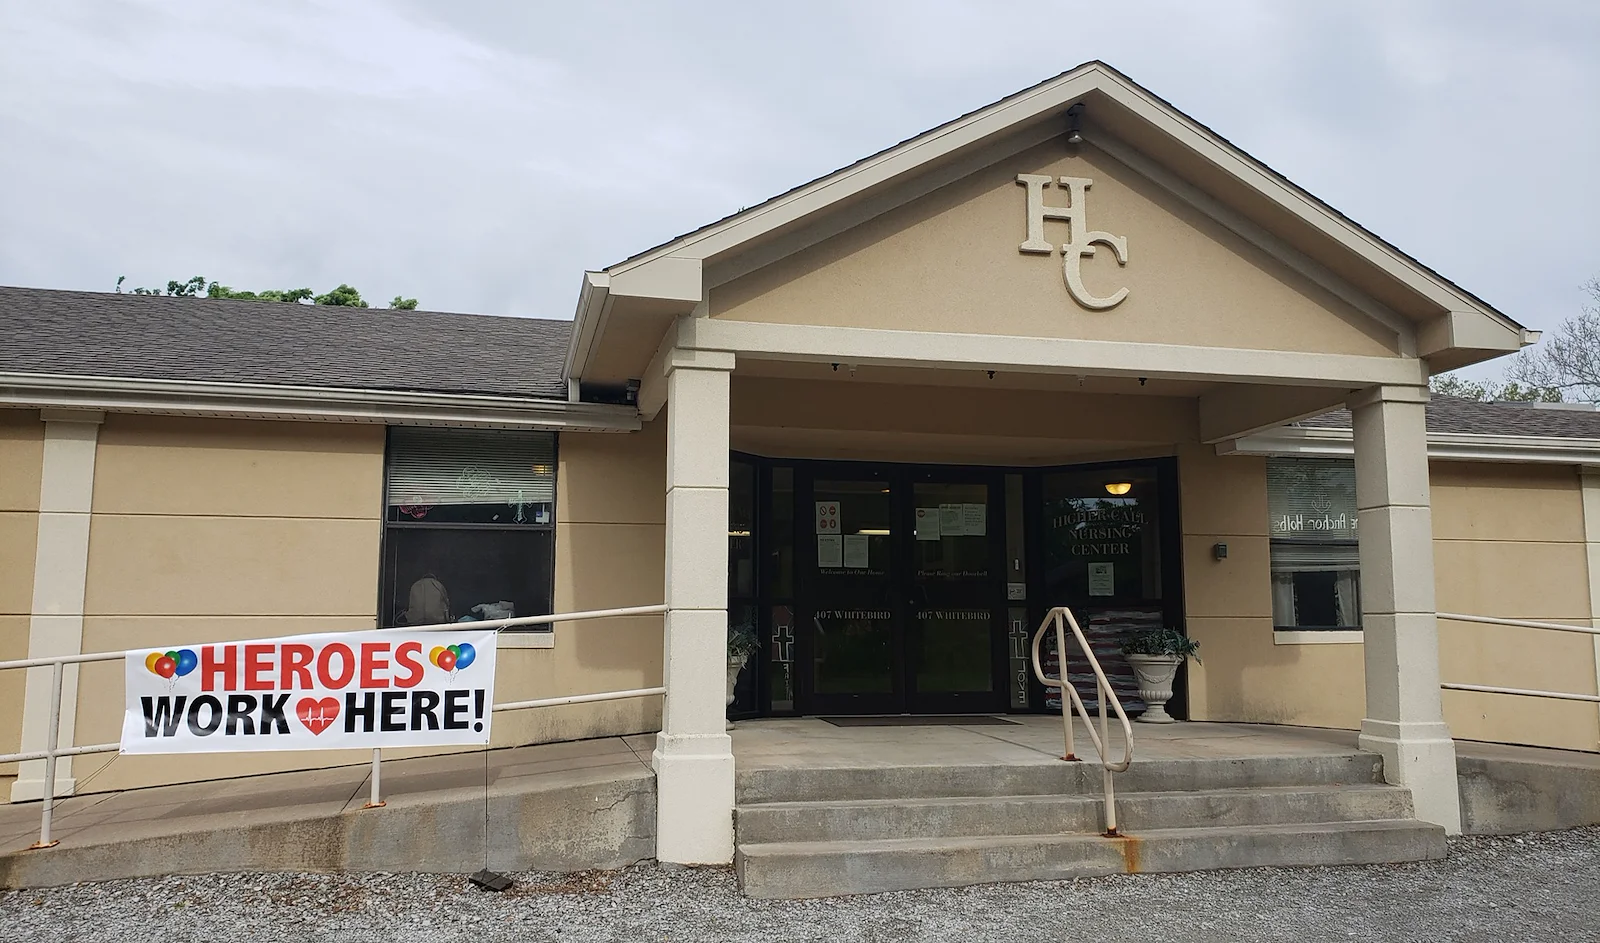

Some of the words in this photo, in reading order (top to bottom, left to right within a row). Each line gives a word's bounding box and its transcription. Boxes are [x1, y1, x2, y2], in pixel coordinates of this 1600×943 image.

[1053, 510, 1107, 528] HIGHER
[1110, 511, 1149, 525] CALL
[1069, 526, 1132, 541] NURSING
[1071, 542, 1130, 556] CENTER
[936, 569, 950, 577] Ring
[962, 569, 988, 577] Doorbell
[814, 610, 833, 620] 407
[833, 610, 891, 620] WHITEBIRD
[915, 611, 933, 621] 407
[934, 611, 991, 621] WHITEBIRD
[200, 641, 425, 692] HEROES
[140, 692, 292, 738] WORK
[343, 689, 486, 735] HERE!
